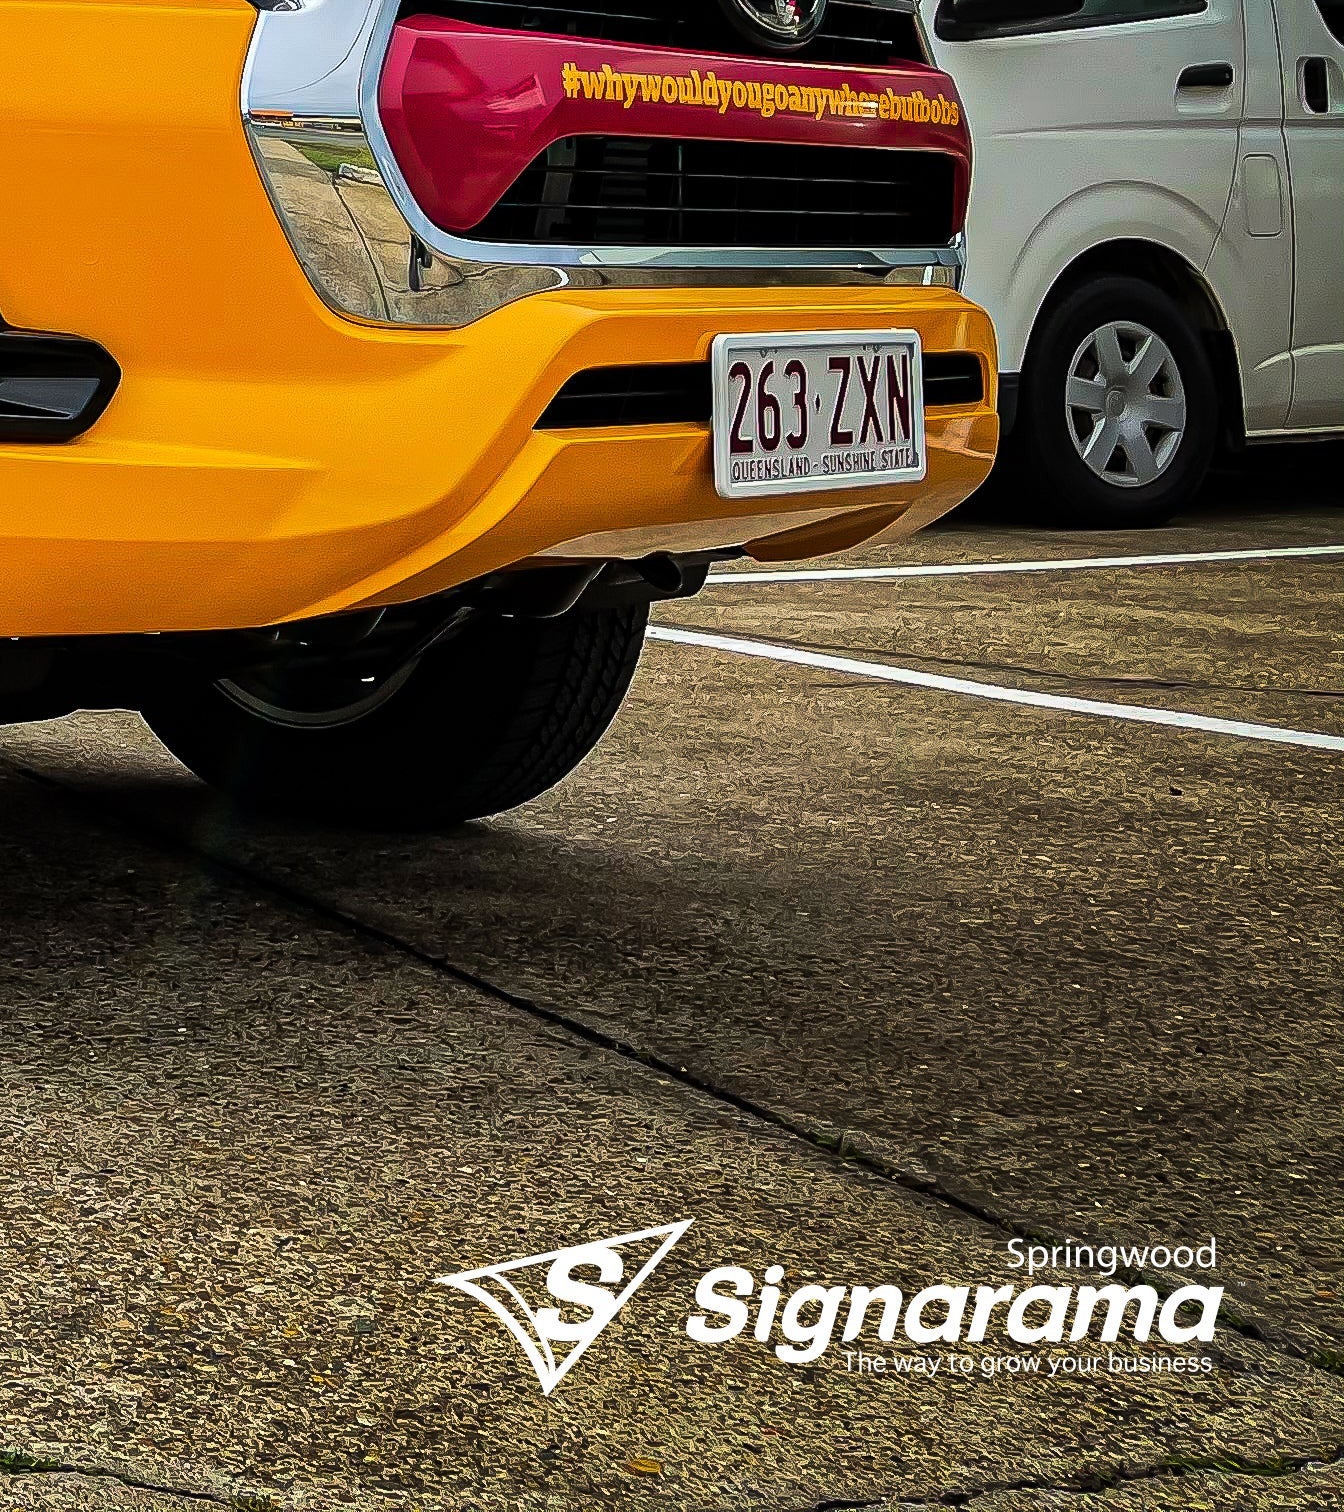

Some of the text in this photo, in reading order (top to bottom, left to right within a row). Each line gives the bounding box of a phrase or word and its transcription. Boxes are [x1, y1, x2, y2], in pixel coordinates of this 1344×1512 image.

[732, 455, 811, 482] QUEENSLAND
[822, 450, 876, 475] SUNSHINE
[881, 447, 912, 469] STATE
